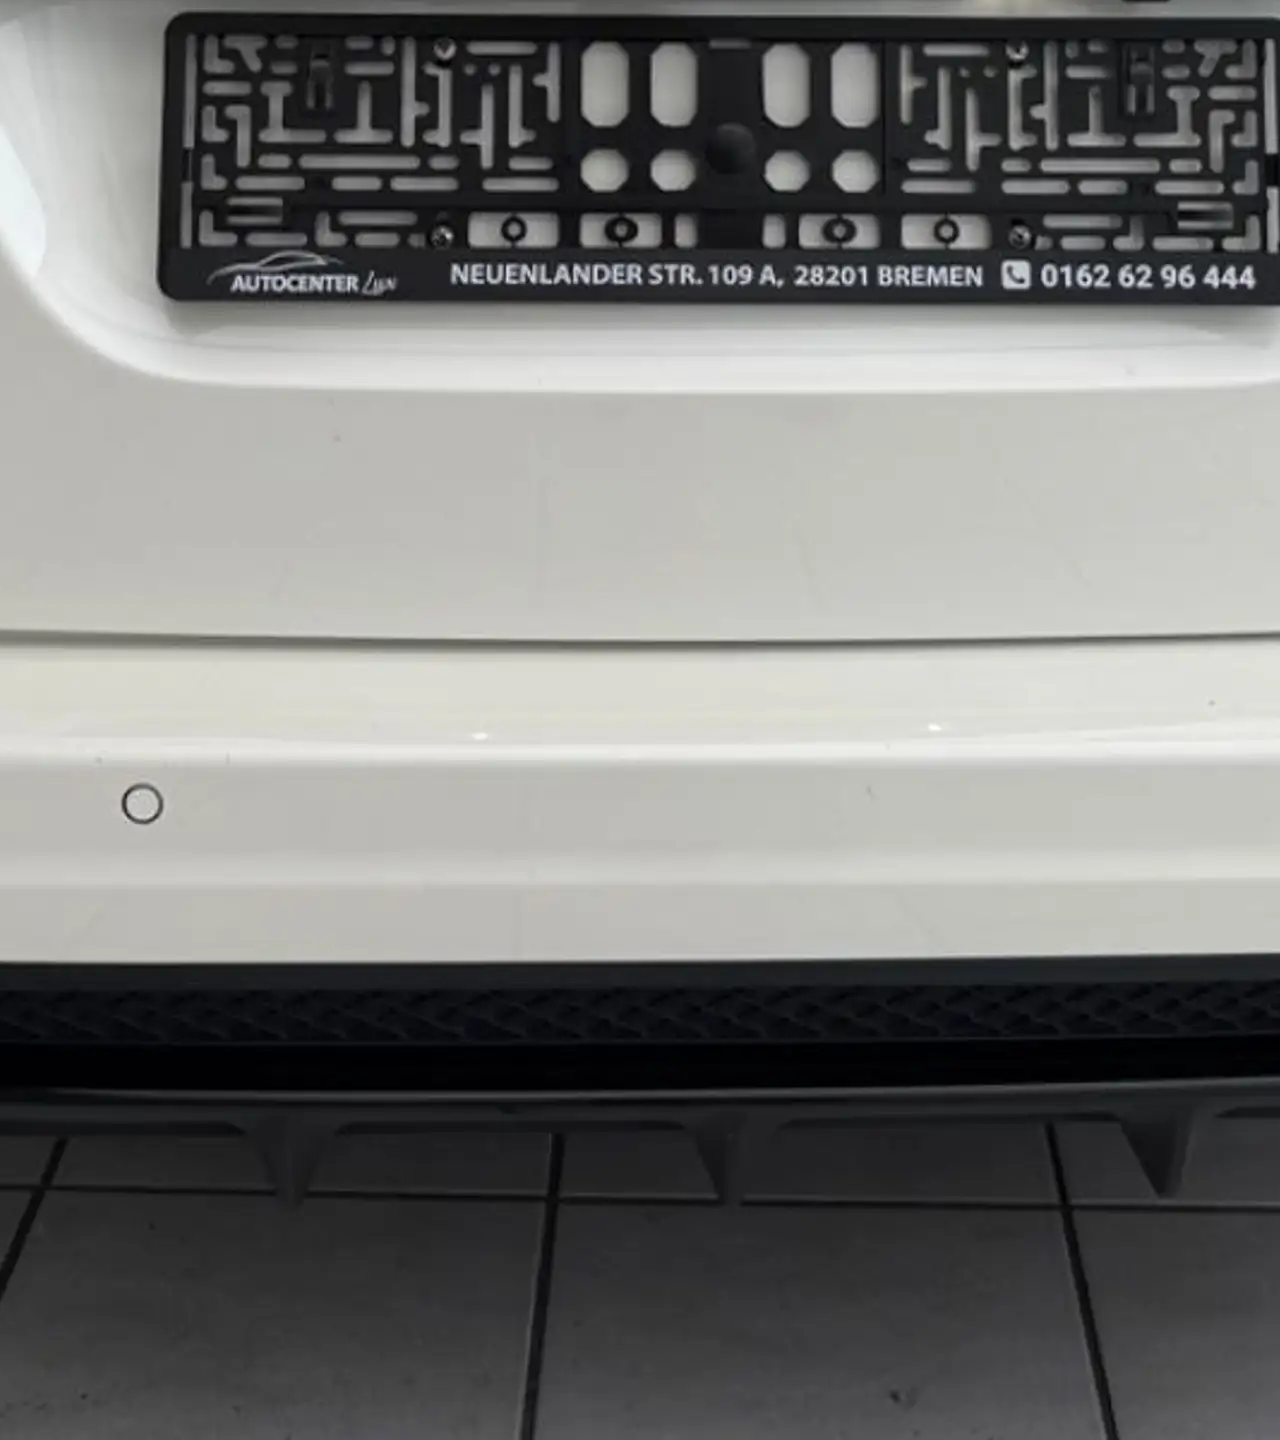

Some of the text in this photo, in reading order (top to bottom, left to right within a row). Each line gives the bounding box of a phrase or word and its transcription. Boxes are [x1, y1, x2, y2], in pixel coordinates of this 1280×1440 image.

[230, 273, 359, 293] AUTOCENTER
[450, 263, 1257, 290] NEUENLANDER STR. 109 A, 28201 BREMEN 0162 62 96 444
